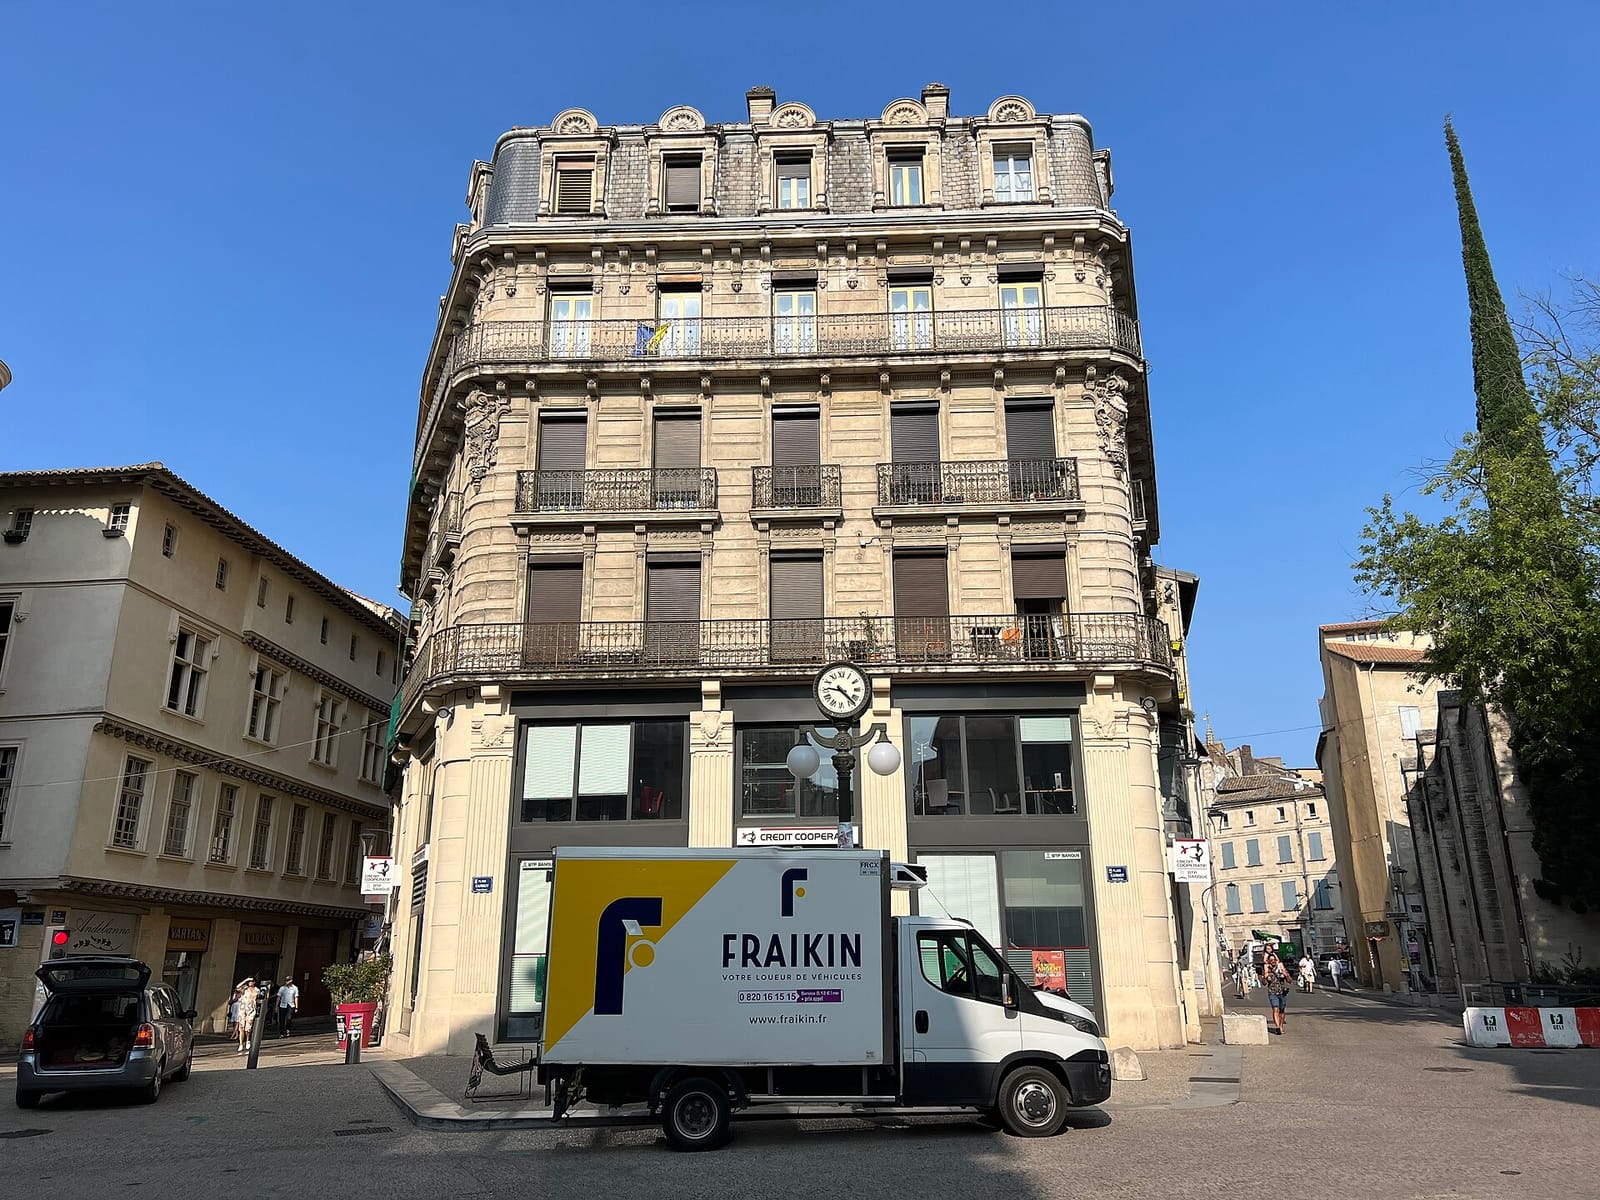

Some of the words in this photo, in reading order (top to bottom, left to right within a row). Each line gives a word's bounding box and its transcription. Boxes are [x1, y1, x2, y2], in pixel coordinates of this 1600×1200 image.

[760, 833, 792, 841] CREDIT
[795, 832, 838, 841] COOPERA
[722, 933, 862, 968] FRAIKIN
[812, 972, 862, 980] VÉHICULES
[746, 993, 761, 1001] 820
[787, 992, 797, 1000] 15
[750, 1014, 827, 1024] www.fraikin.fr
